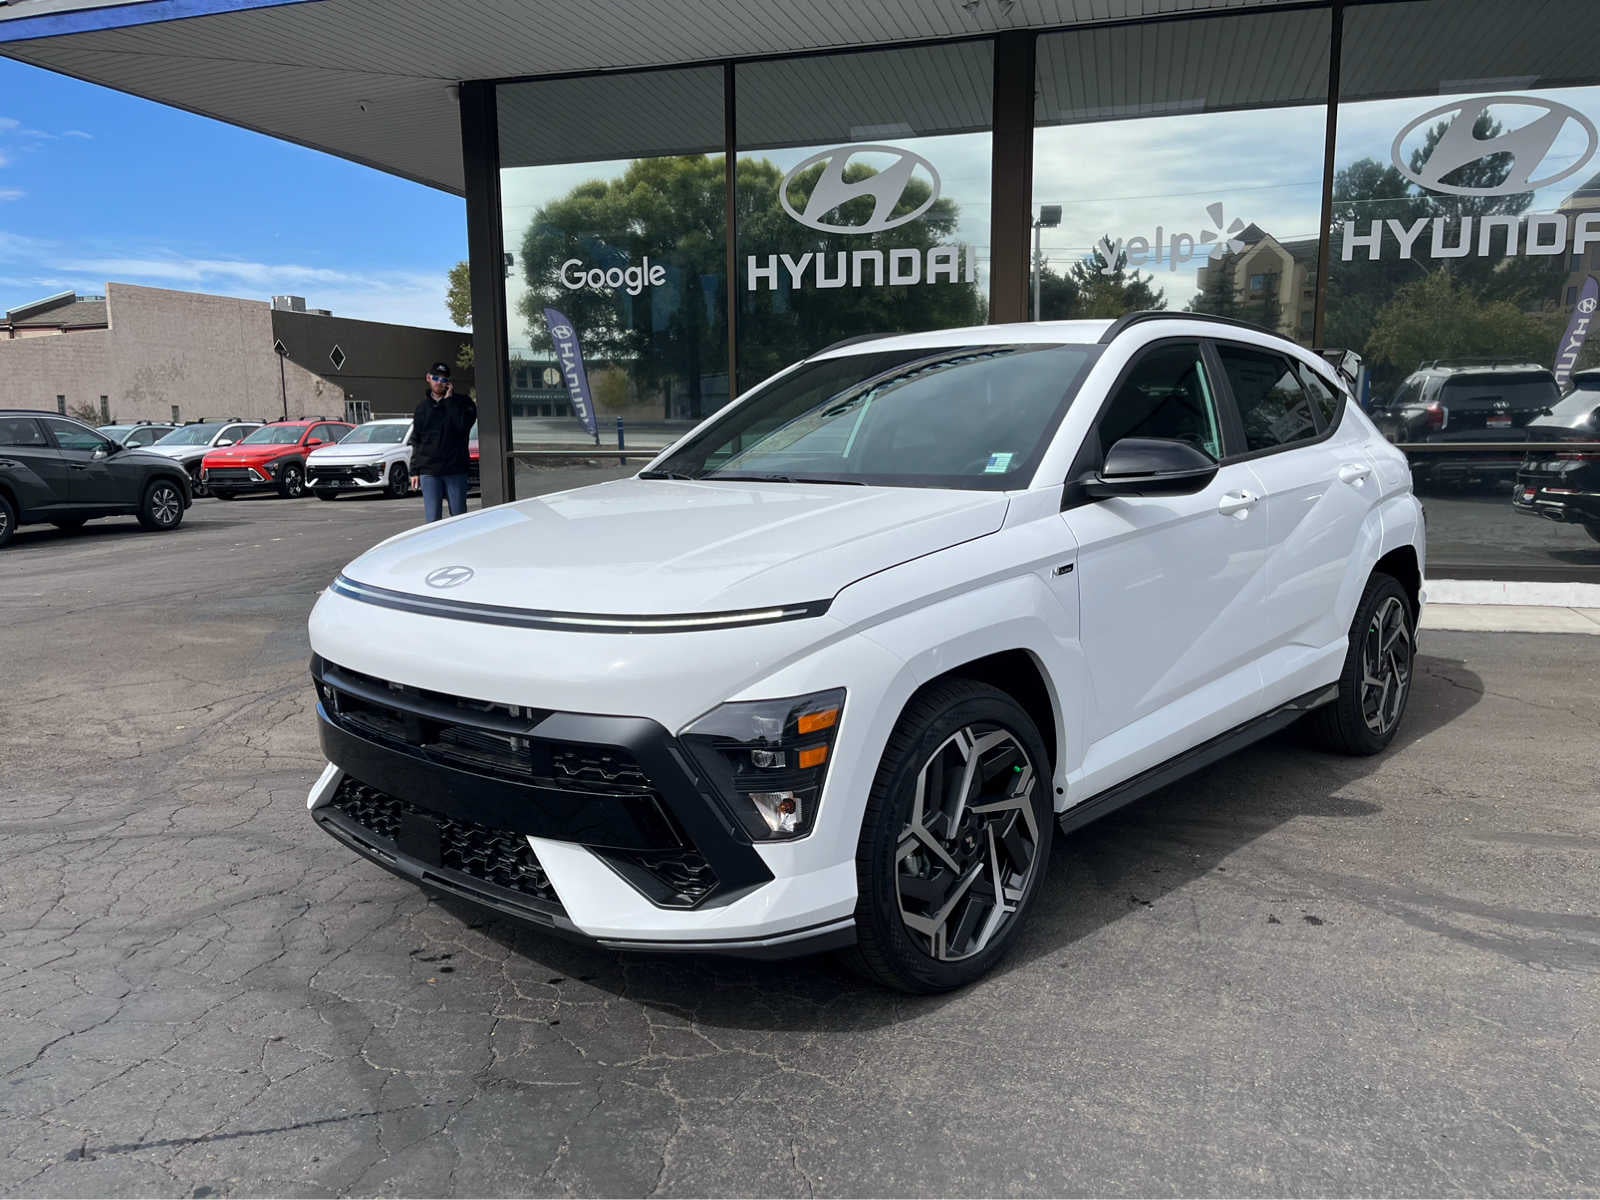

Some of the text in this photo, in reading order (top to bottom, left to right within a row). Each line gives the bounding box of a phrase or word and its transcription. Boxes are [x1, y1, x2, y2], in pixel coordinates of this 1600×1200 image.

[747, 246, 977, 291] HYUNDAI
[1098, 226, 1194, 275] yelp
[561, 256, 666, 296] Google
